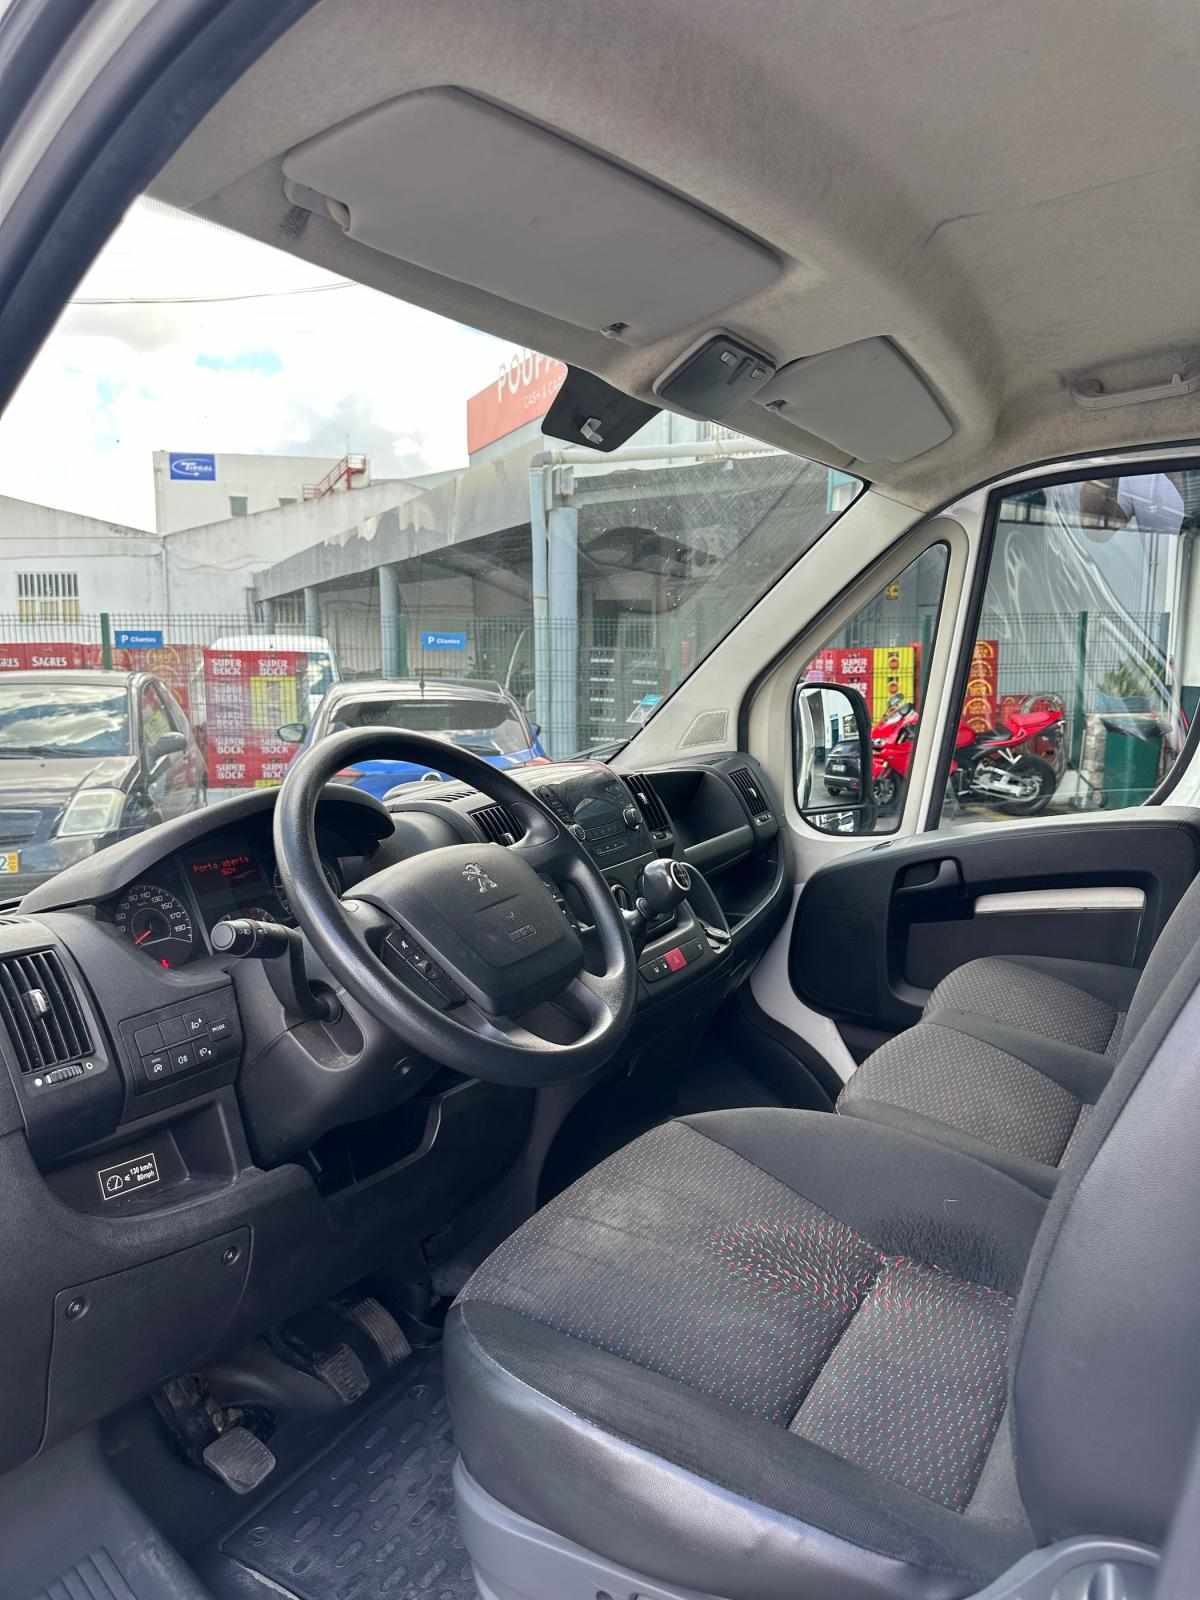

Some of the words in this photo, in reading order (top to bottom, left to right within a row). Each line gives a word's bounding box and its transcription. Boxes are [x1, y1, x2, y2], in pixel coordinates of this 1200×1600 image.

[32, 656, 67, 667] SAGRES
[216, 763, 246, 771] SUPER
[217, 771, 245, 779] BOCK
[151, 895, 163, 903] 130
[160, 902, 173, 910] 150
[169, 912, 182, 920] 170
[130, 1166, 140, 1175] 130
